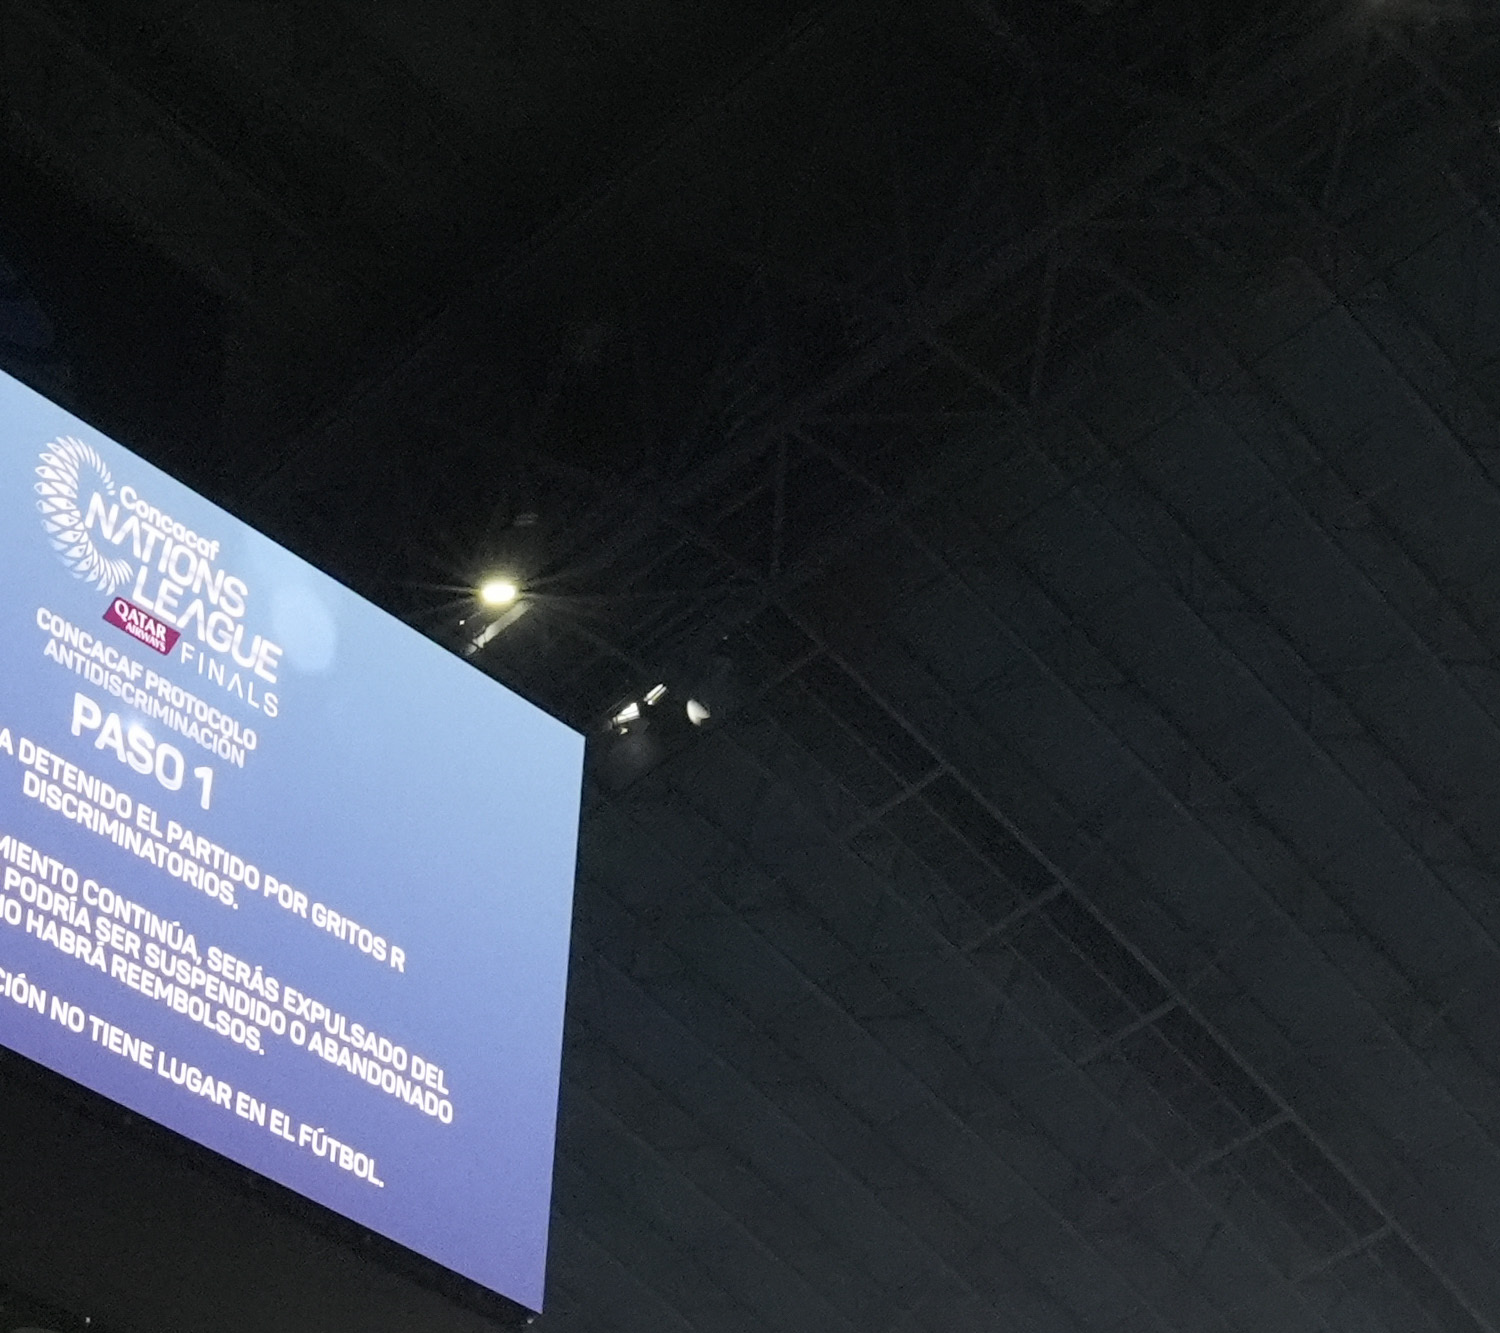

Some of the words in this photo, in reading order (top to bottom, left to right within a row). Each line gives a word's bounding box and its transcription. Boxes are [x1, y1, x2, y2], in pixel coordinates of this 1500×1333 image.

[84, 492, 249, 619] NATIONS
[120, 485, 220, 562] Concacaf
[36, 607, 144, 681] CONCACAF
[145, 669, 257, 751] PROTOCOLO
[113, 601, 167, 638] QATAR
[125, 621, 168, 653] AIRWAYS
[133, 565, 284, 685] LEAGUE
[181, 643, 280, 719] FINALS
[43, 638, 246, 769] ANTIDISCRIMINACIÓN
[71, 692, 185, 791] PASO
[194, 766, 213, 810] 1
[18, 737, 133, 819] DETENIDO
[136, 803, 163, 839] EL
[166, 820, 260, 891] PARTIDO
[263, 874, 309, 919] POR
[311, 902, 387, 962] GRITOS
[390, 945, 406, 973] R
[22, 770, 239, 910] DISCRIMINATORIOS.
[3, 866, 92, 934] PODRÍA
[95, 916, 141, 960] SER
[144, 942, 286, 1036] SUSPENDIDO
[289, 1020, 306, 1046] O
[307, 1031, 453, 1125] ABANDONADO
[26, 908, 107, 973] HABRÁ
[111, 953, 265, 1056] REEMBOLSOS.
[82, 879, 203, 966] CONTINÚA,
[206, 946, 280, 1003] SERÁS
[283, 986, 408, 1071] EXPULSADO
[411, 1055, 449, 1096] DEL
[50, 995, 85, 1033] NO
[89, 1014, 155, 1070] TIENE
[157, 1050, 233, 1110] LUGAR
[235, 1091, 266, 1127] EN
[269, 1108, 296, 1143] EL
[298, 1123, 385, 1188] FÚTBOL.
